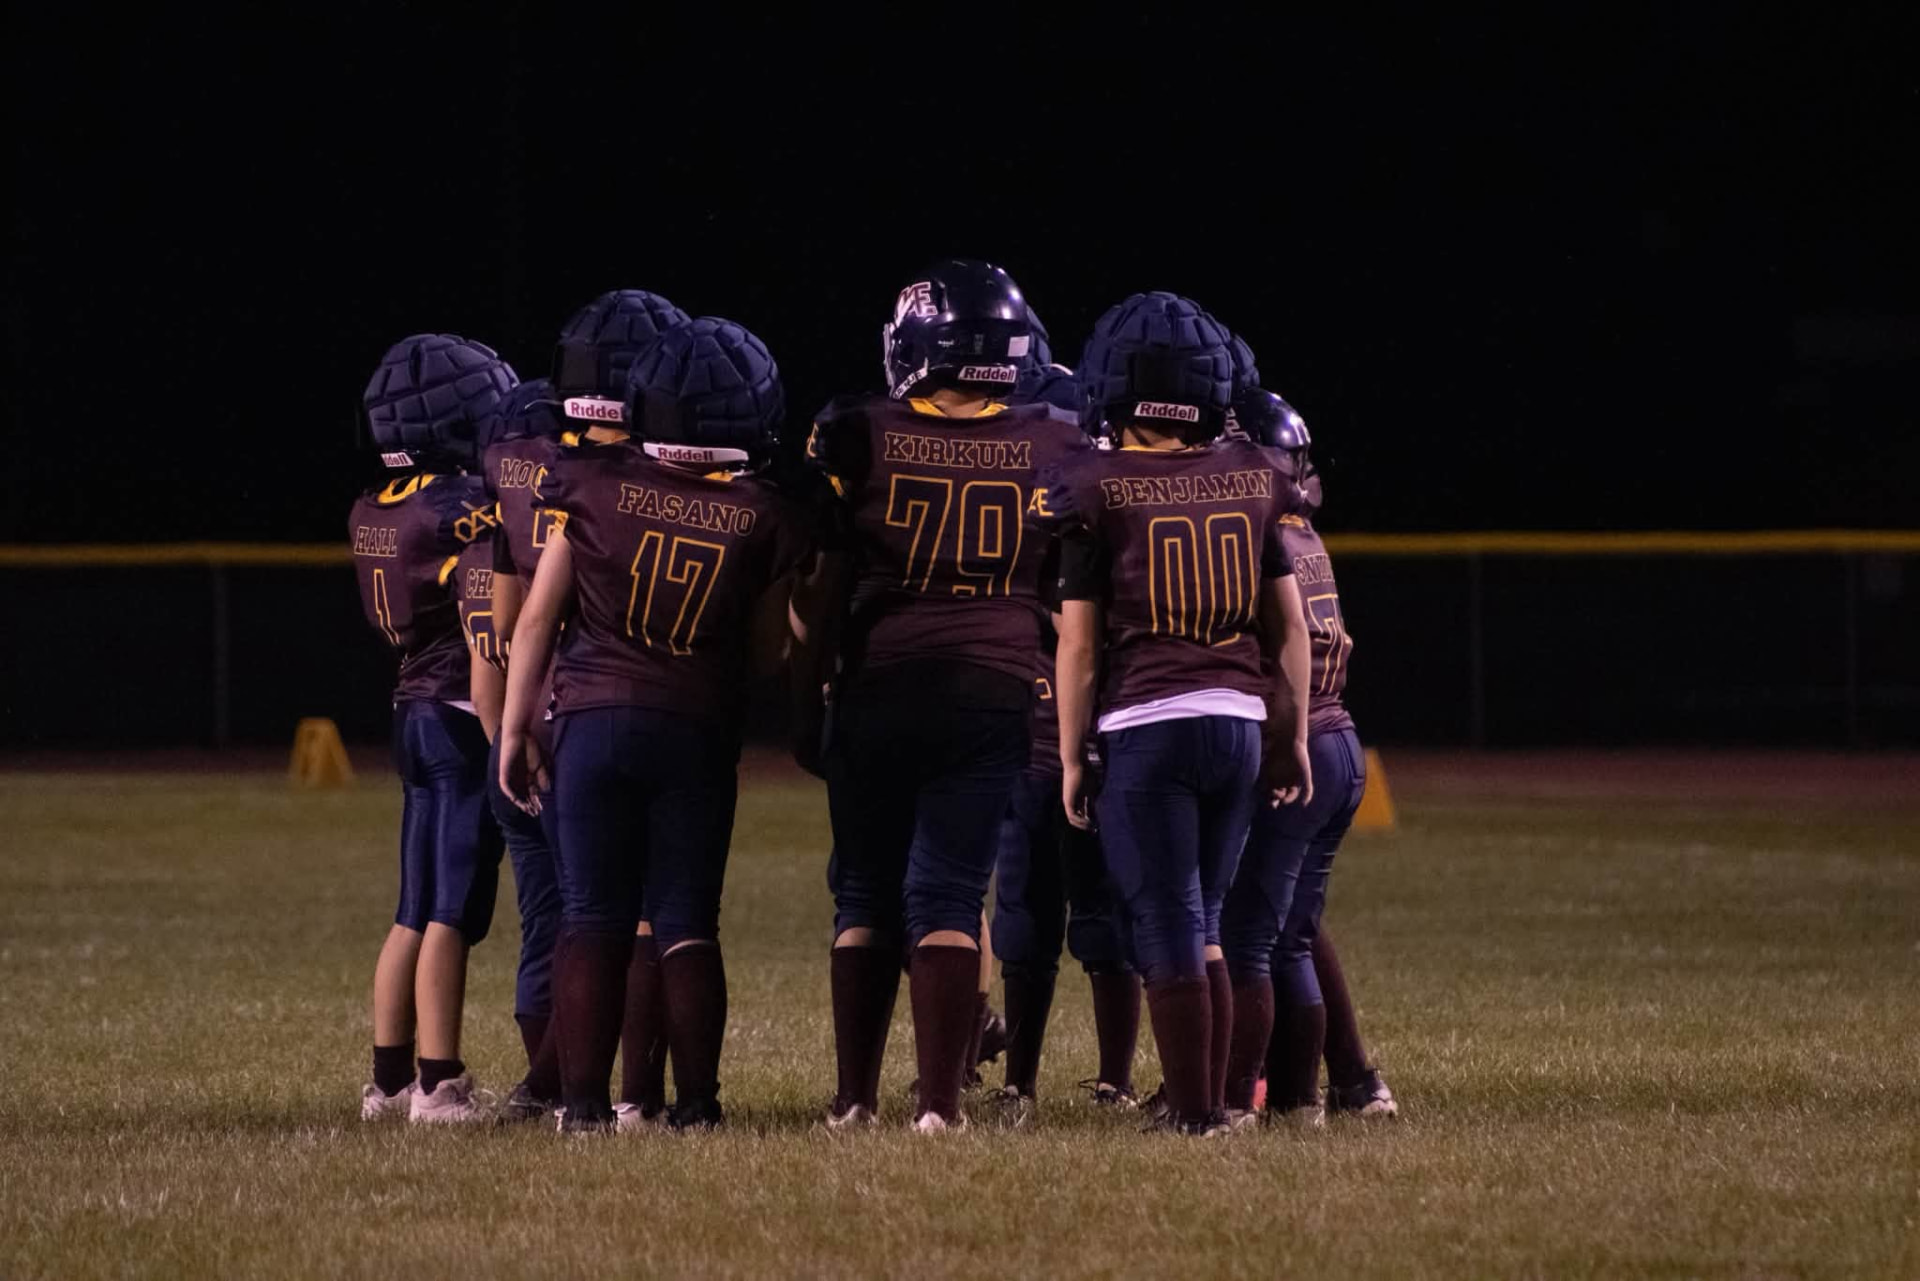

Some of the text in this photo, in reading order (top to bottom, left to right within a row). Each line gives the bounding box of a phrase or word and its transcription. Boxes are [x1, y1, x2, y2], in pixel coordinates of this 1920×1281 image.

[964, 367, 1014, 383] Riddell
[571, 401, 624, 419] Riddel
[1139, 402, 1196, 421] Riddell
[658, 447, 713, 461] Riddell
[884, 431, 1031, 470] KIRKUM
[1101, 469, 1273, 510] BENJAMIN
[617, 483, 756, 537] FASANO
[354, 526, 398, 557] HALL
[885, 473, 1023, 600] 79
[465, 568, 493, 598] CH
[626, 530, 726, 656] 17
[1148, 512, 1256, 647] 00
[373, 568, 400, 646] 1
